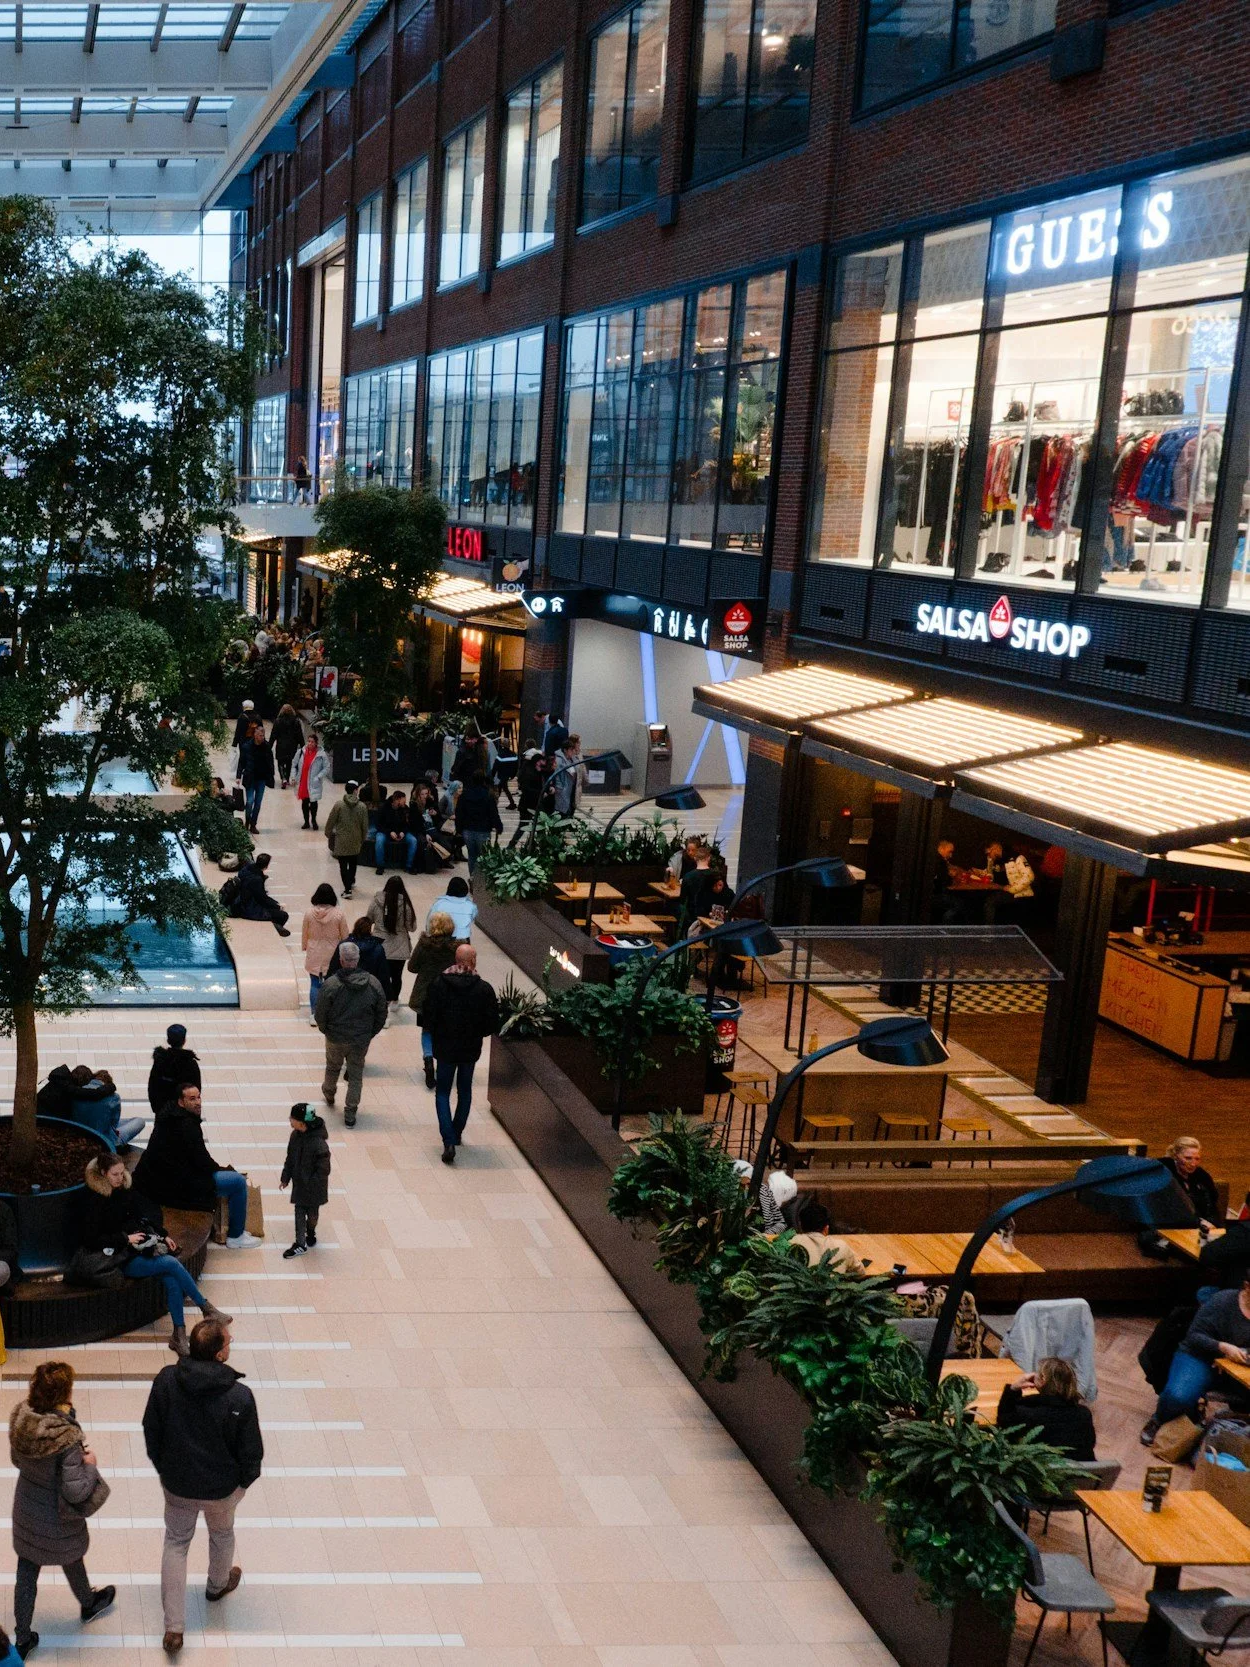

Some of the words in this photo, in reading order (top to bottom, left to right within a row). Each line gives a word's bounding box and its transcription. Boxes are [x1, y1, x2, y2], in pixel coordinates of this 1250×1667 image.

[447, 526, 483, 561] LEON
[495, 582, 525, 593] LEON
[916, 603, 990, 643] SALSA
[1010, 616, 1091, 658] SHOP
[723, 634, 749, 642] SALSA
[724, 641, 748, 649] SHOP
[352, 747, 399, 762] LEON
[713, 1055, 734, 1064] SHOP
